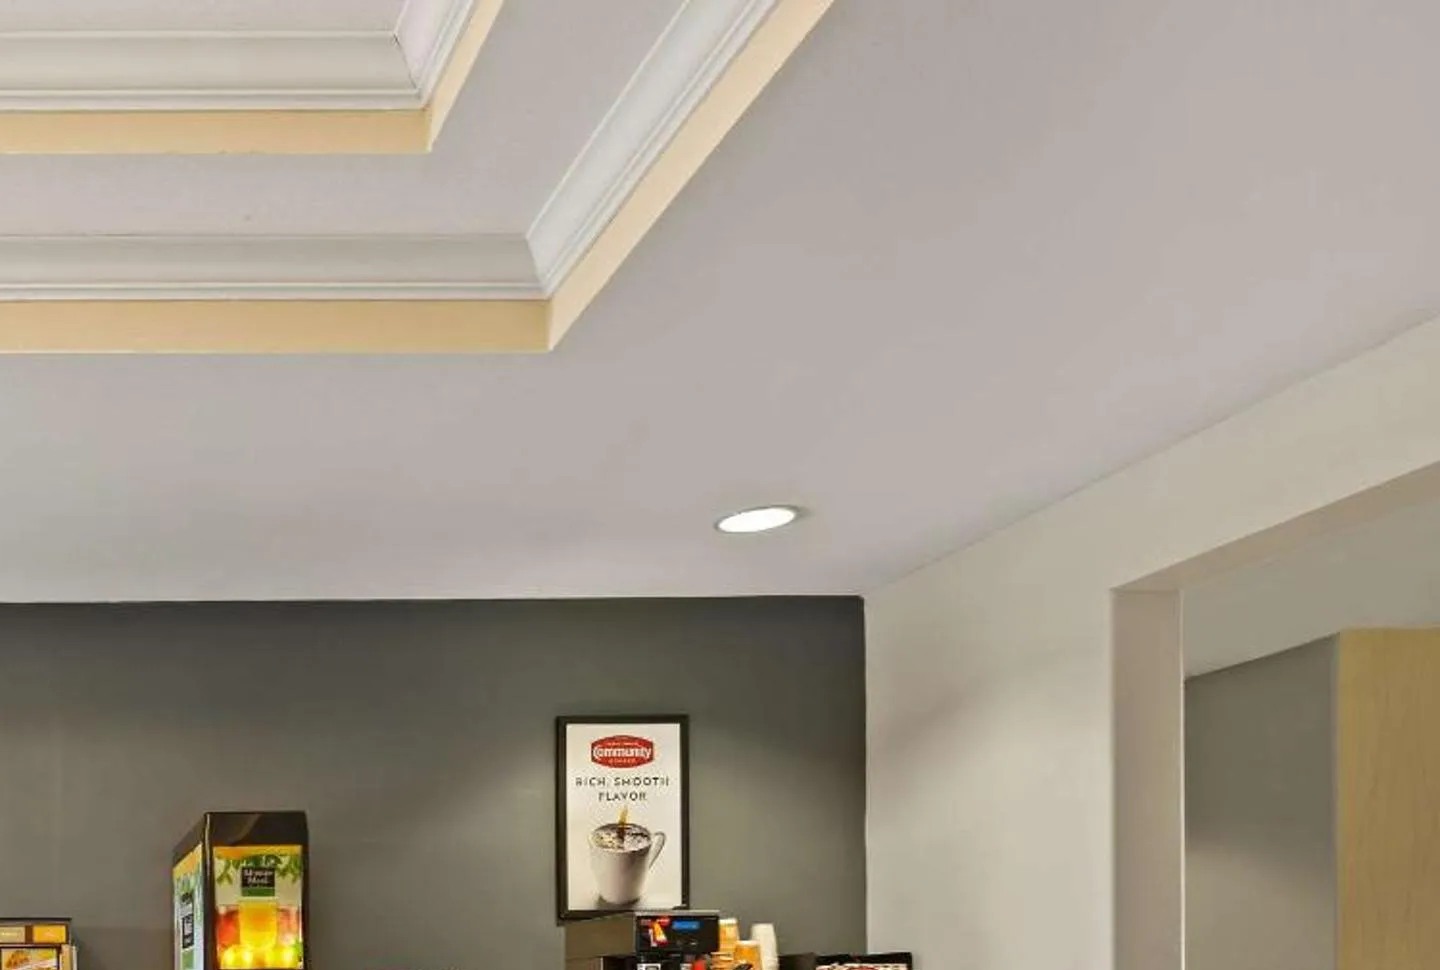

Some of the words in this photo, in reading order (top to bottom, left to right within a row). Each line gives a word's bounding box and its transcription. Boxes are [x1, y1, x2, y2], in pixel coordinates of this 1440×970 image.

[591, 745, 652, 760] Community
[614, 776, 669, 787] SMOOTH
[598, 791, 648, 802] FLAVOR
